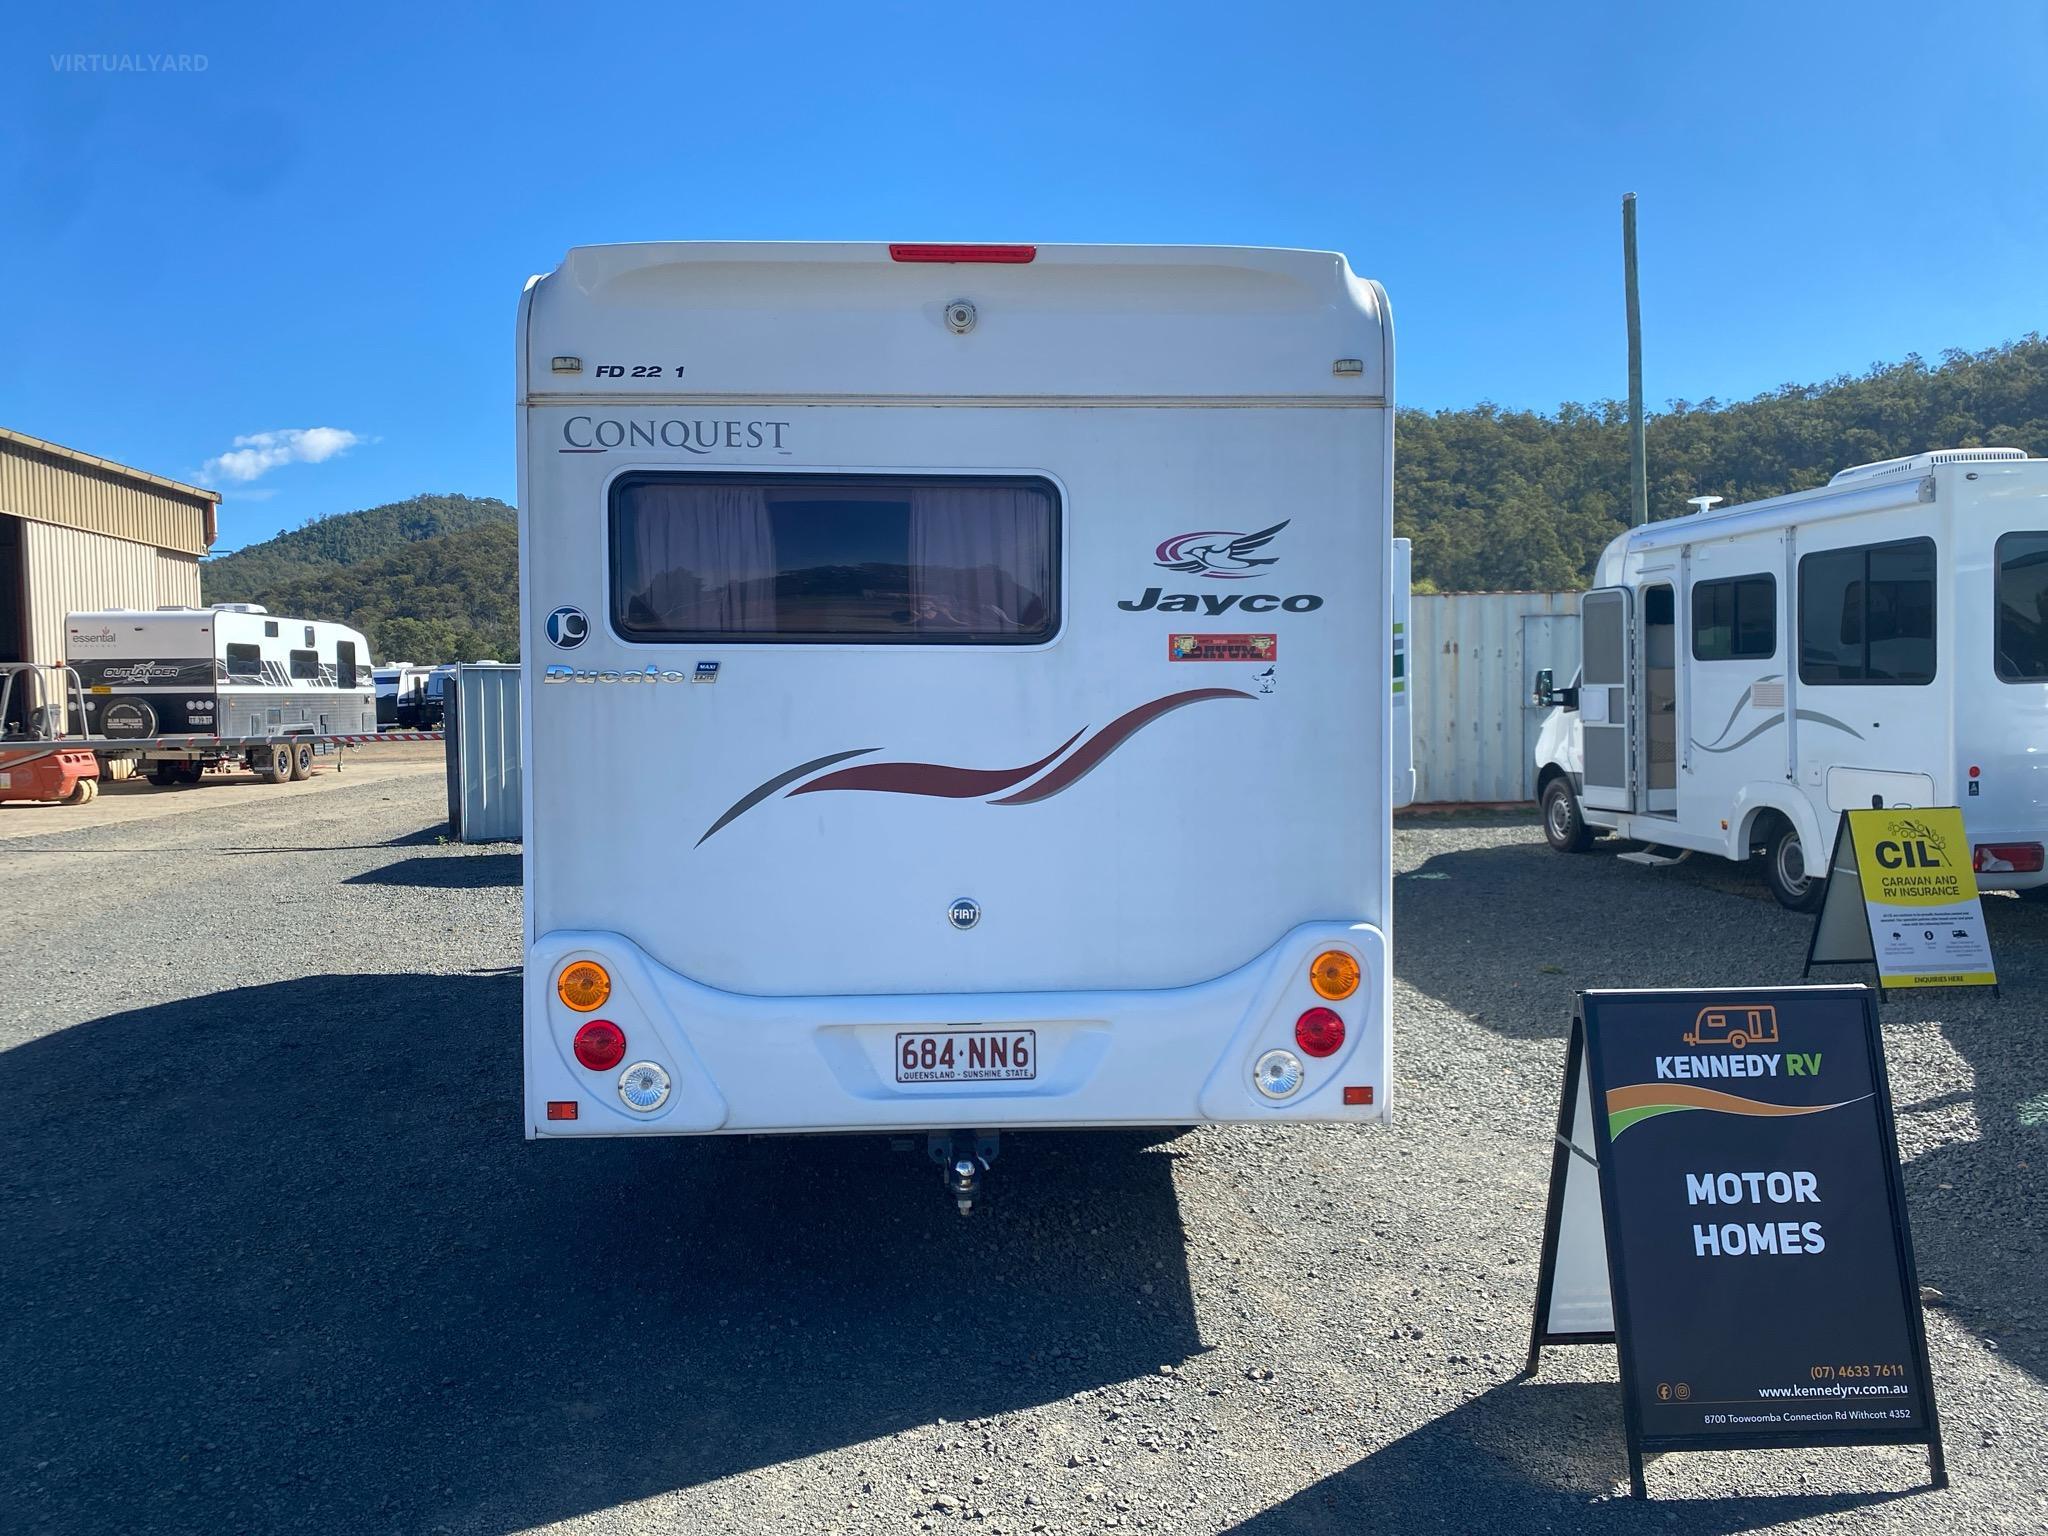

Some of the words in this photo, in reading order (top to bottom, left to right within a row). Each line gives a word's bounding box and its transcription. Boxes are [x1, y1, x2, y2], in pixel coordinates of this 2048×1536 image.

[595, 365, 625, 378] FD
[630, 365, 662, 378] 22
[675, 366, 685, 378] 1
[563, 416, 790, 454] CONQUEST
[1117, 587, 1324, 616] Jayco
[73, 633, 116, 643] essential
[103, 667, 179, 678] OUTLANDER
[544, 664, 685, 684] Ducato
[1875, 840, 1941, 869] CIL
[1881, 876, 1931, 887] CARAVAN
[1935, 875, 1957, 885] AND
[1883, 888, 1897, 897] RV
[1900, 886, 1960, 897] INSURANCE
[953, 908, 975, 919] FIAT
[1914, 976, 1947, 984] ENQUIRIES
[1947, 975, 1964, 983] HERE
[1655, 1054, 1781, 1079] KENNEDY
[1785, 1053, 1822, 1077] RV
[903, 1070, 955, 1080] QUEENSLAND
[963, 1069, 1001, 1078] SUNSHINE
[1005, 1069, 1029, 1077] STATE
[1686, 1171, 1821, 1205] MOTOR
[1693, 1221, 1826, 1256] HOMES
[1810, 1366, 1835, 1380] (07)
[1838, 1365, 1871, 1377] 4633
[1874, 1364, 1904, 1377] 7611
[1758, 1383, 1908, 1399] www.kennedyrv.com.au
[1704, 1415, 1726, 1424] 8700
[1728, 1413, 1781, 1423] Toowoomba
[1783, 1412, 1833, 1422] Connection
[1835, 1411, 1847, 1420] Rd
[1849, 1410, 1887, 1420] Withcott
[1889, 1409, 1911, 1419] 4352
